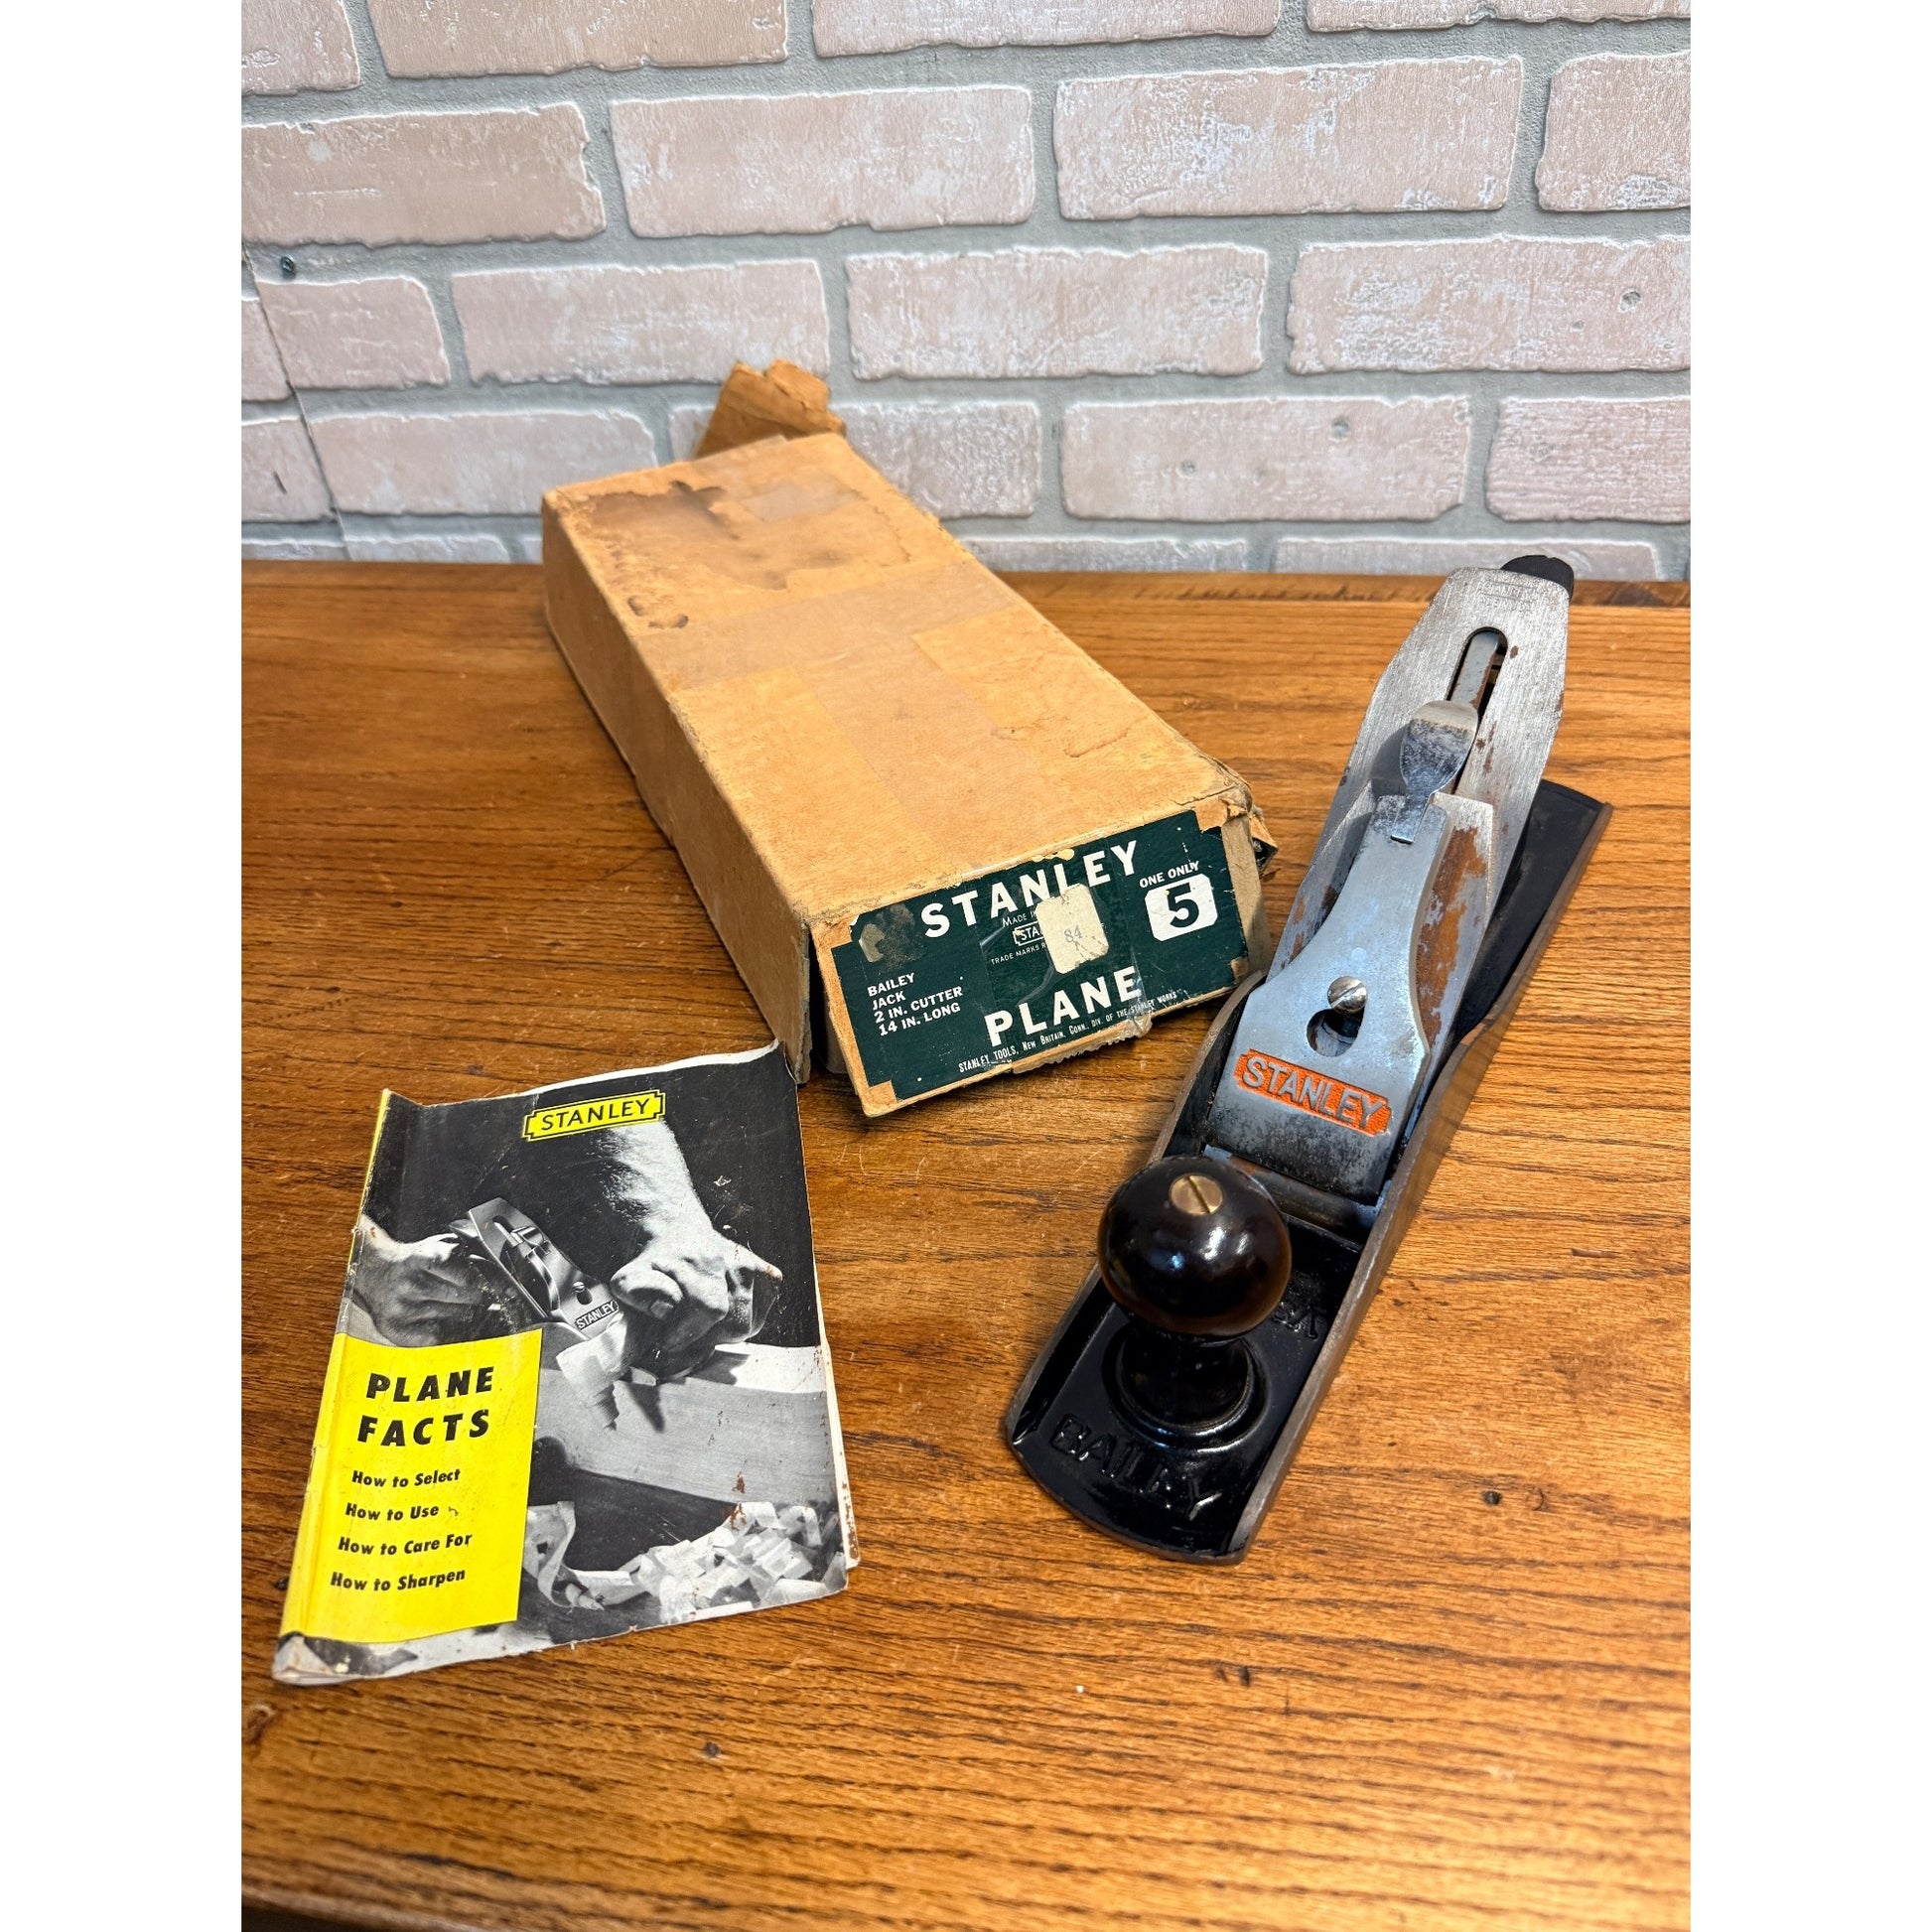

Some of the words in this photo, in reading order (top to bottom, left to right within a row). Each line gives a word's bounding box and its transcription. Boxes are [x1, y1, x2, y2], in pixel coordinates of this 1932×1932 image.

[920, 840, 1137, 938] STANLEY
[1139, 872, 1166, 888] ONE
[1167, 861, 1199, 879] ONLY
[1165, 882, 1199, 928] 5
[1063, 924, 1083, 943] 84
[991, 953, 1015, 965] TRADE
[1016, 945, 1040, 956] MARKS
[867, 972, 914, 997] BAILEY
[872, 991, 906, 1011] JACK
[874, 1011, 885, 1024] 2
[888, 1006, 907, 1019] IN.
[910, 986, 963, 1011] CUTTER
[984, 965, 1142, 1047] PLANE
[879, 1021, 898, 1036] 14
[901, 1016, 921, 1030] IN.
[923, 1002, 961, 1023] LONG
[958, 1054, 990, 1073] STANLEY
[993, 1045, 1019, 1060] TOOLS,
[1106, 1013, 1113, 1023] OF
[1116, 1008, 1128, 1019] THE
[1241, 1055, 1385, 1130] STANLEY
[541, 1097, 650, 1131] STANLEY
[576, 1301, 616, 1328] STANLEY
[366, 1366, 494, 1402] PLANE
[357, 1409, 489, 1447] FACTS
[351, 1469, 387, 1487] How
[392, 1476, 409, 1488] to
[414, 1468, 461, 1486] Select
[345, 1502, 381, 1520] How
[386, 1509, 404, 1521] to
[410, 1506, 439, 1519] Use
[338, 1536, 374, 1555] How
[380, 1543, 397, 1556] to
[404, 1539, 440, 1554] Care
[445, 1534, 473, 1549] For
[331, 1571, 367, 1590] How
[373, 1579, 391, 1591] to
[397, 1570, 466, 1590] Sharpen
